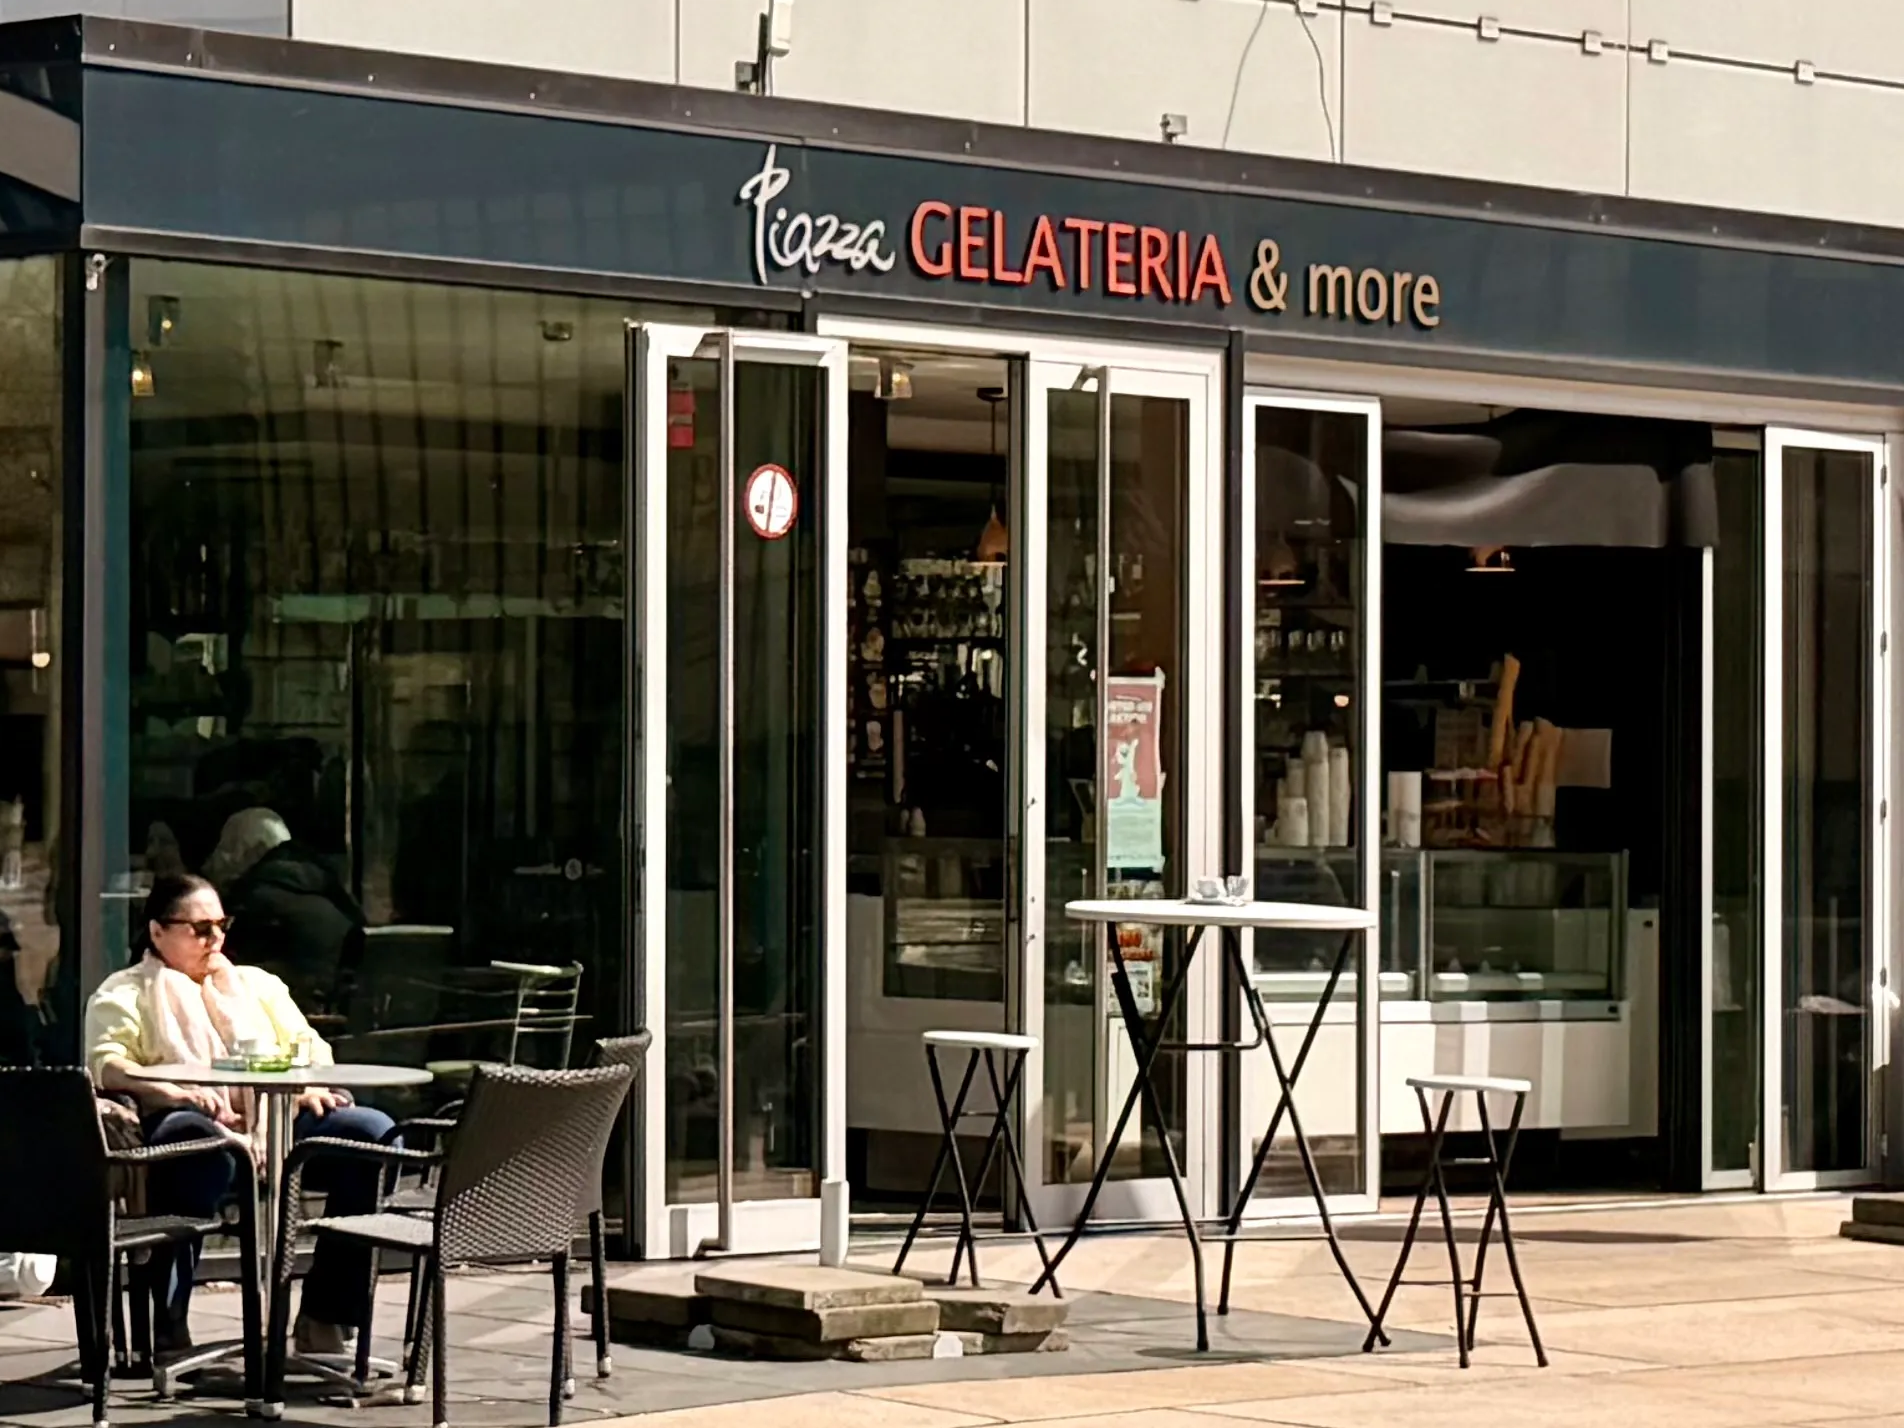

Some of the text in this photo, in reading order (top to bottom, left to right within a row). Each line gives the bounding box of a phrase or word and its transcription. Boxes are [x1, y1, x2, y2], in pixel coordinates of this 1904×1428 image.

[739, 143, 1441, 328] Piazza GELATERIA & more
